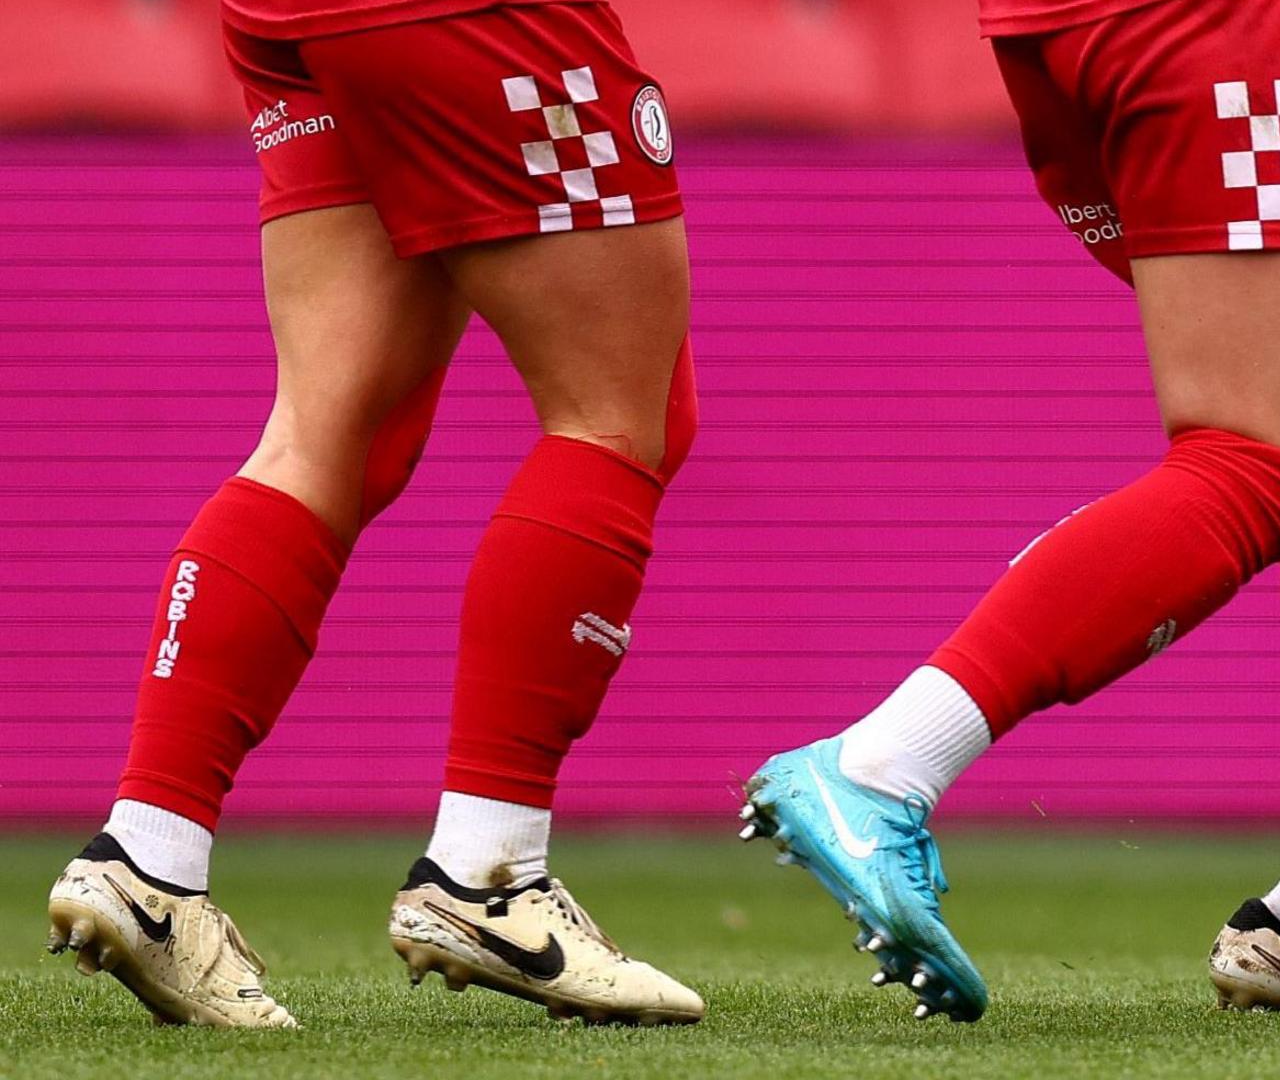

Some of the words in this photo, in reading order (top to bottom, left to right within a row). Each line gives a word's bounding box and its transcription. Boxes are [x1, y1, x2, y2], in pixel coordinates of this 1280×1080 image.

[252, 114, 336, 154] Goodman
[1058, 202, 1117, 225] lbert
[151, 560, 200, 679] ROBINS
